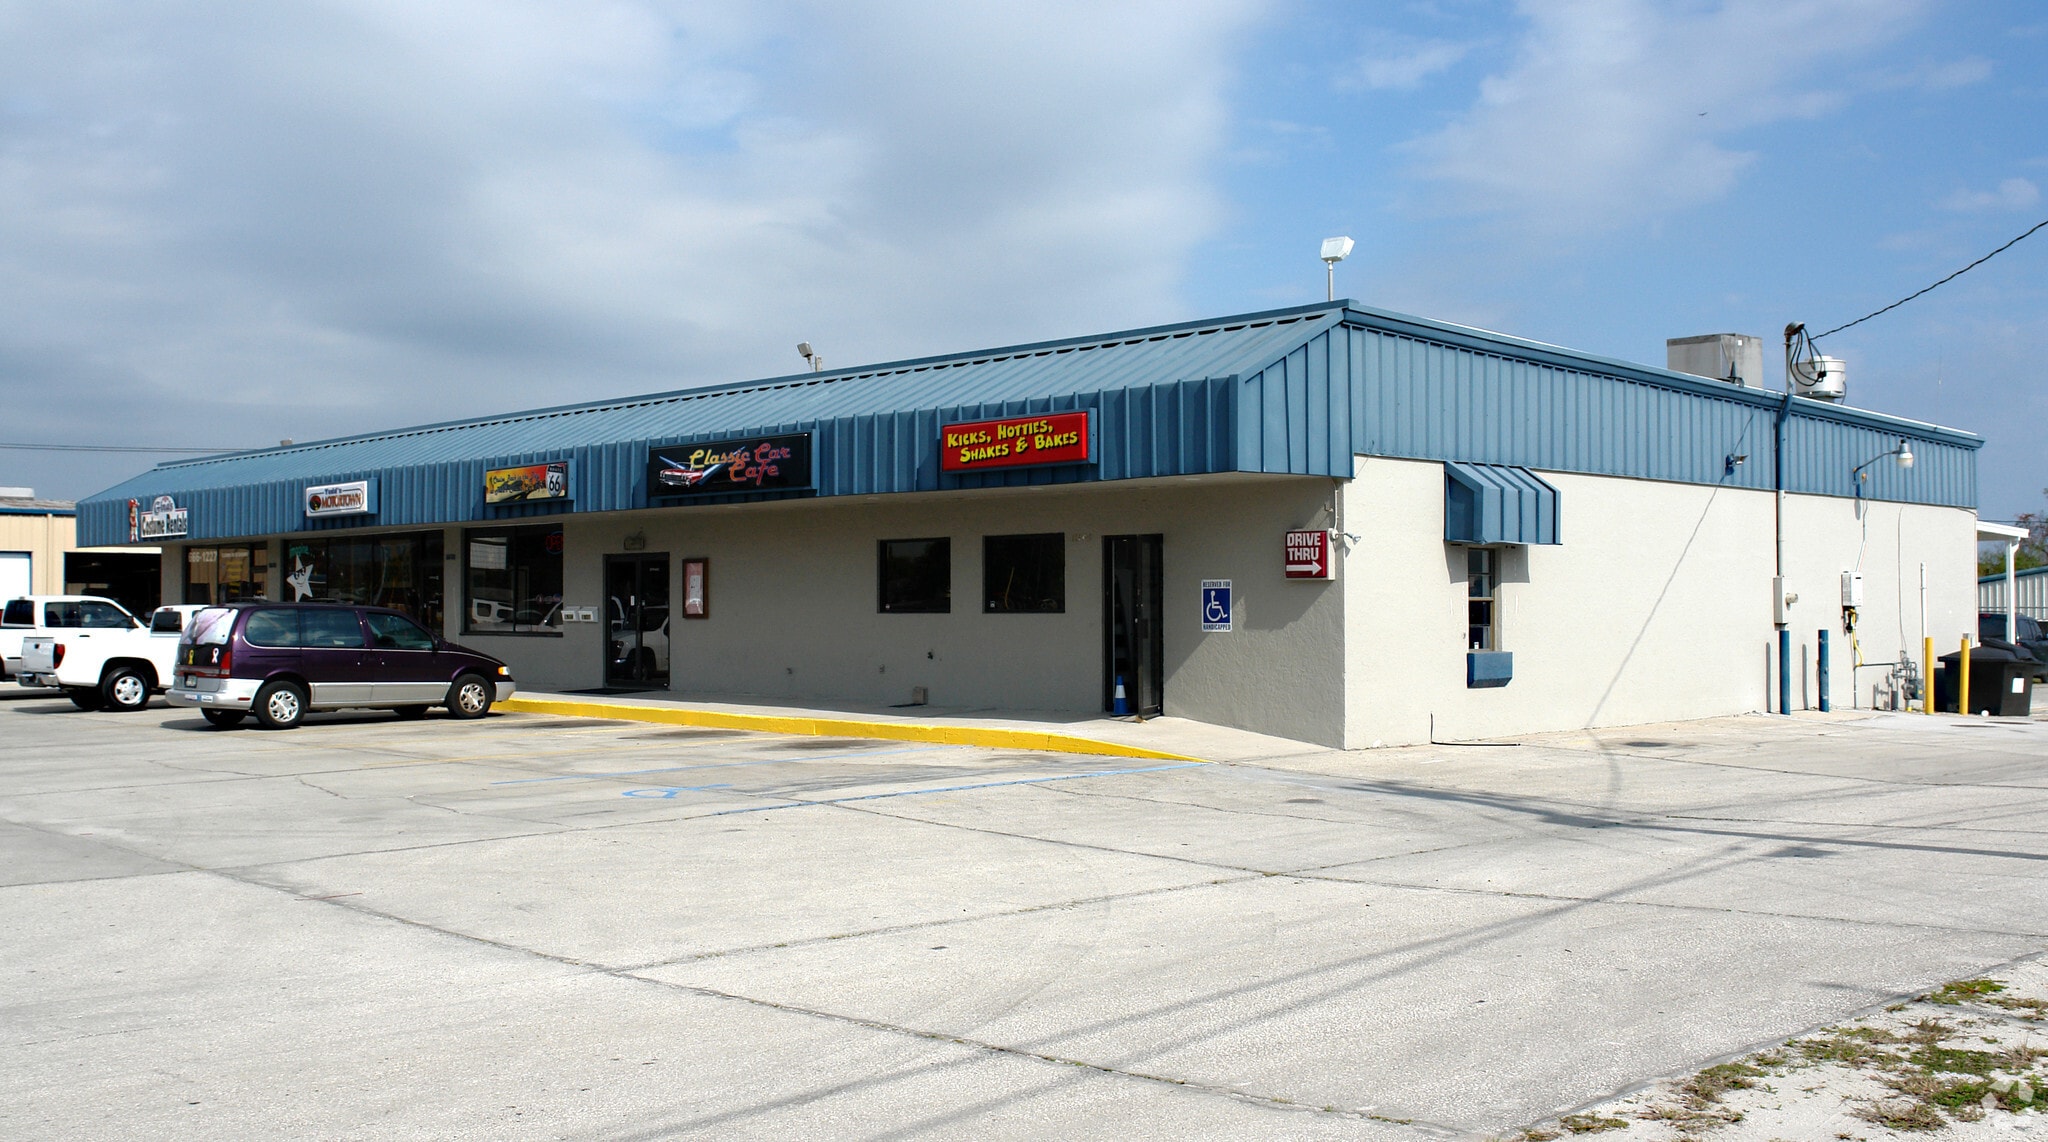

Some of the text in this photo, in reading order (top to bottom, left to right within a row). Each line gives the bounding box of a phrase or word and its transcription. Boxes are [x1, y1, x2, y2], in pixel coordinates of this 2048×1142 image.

[689, 442, 791, 469] Classic Car
[959, 431, 1078, 463] SHAKES & BAKES
[728, 459, 779, 485] Cafe
[548, 474, 561, 492] 66
[1286, 532, 1321, 547] DRIVE
[1287, 547, 1320, 561] THRU
[1203, 623, 1231, 631] HANDICAPPED
